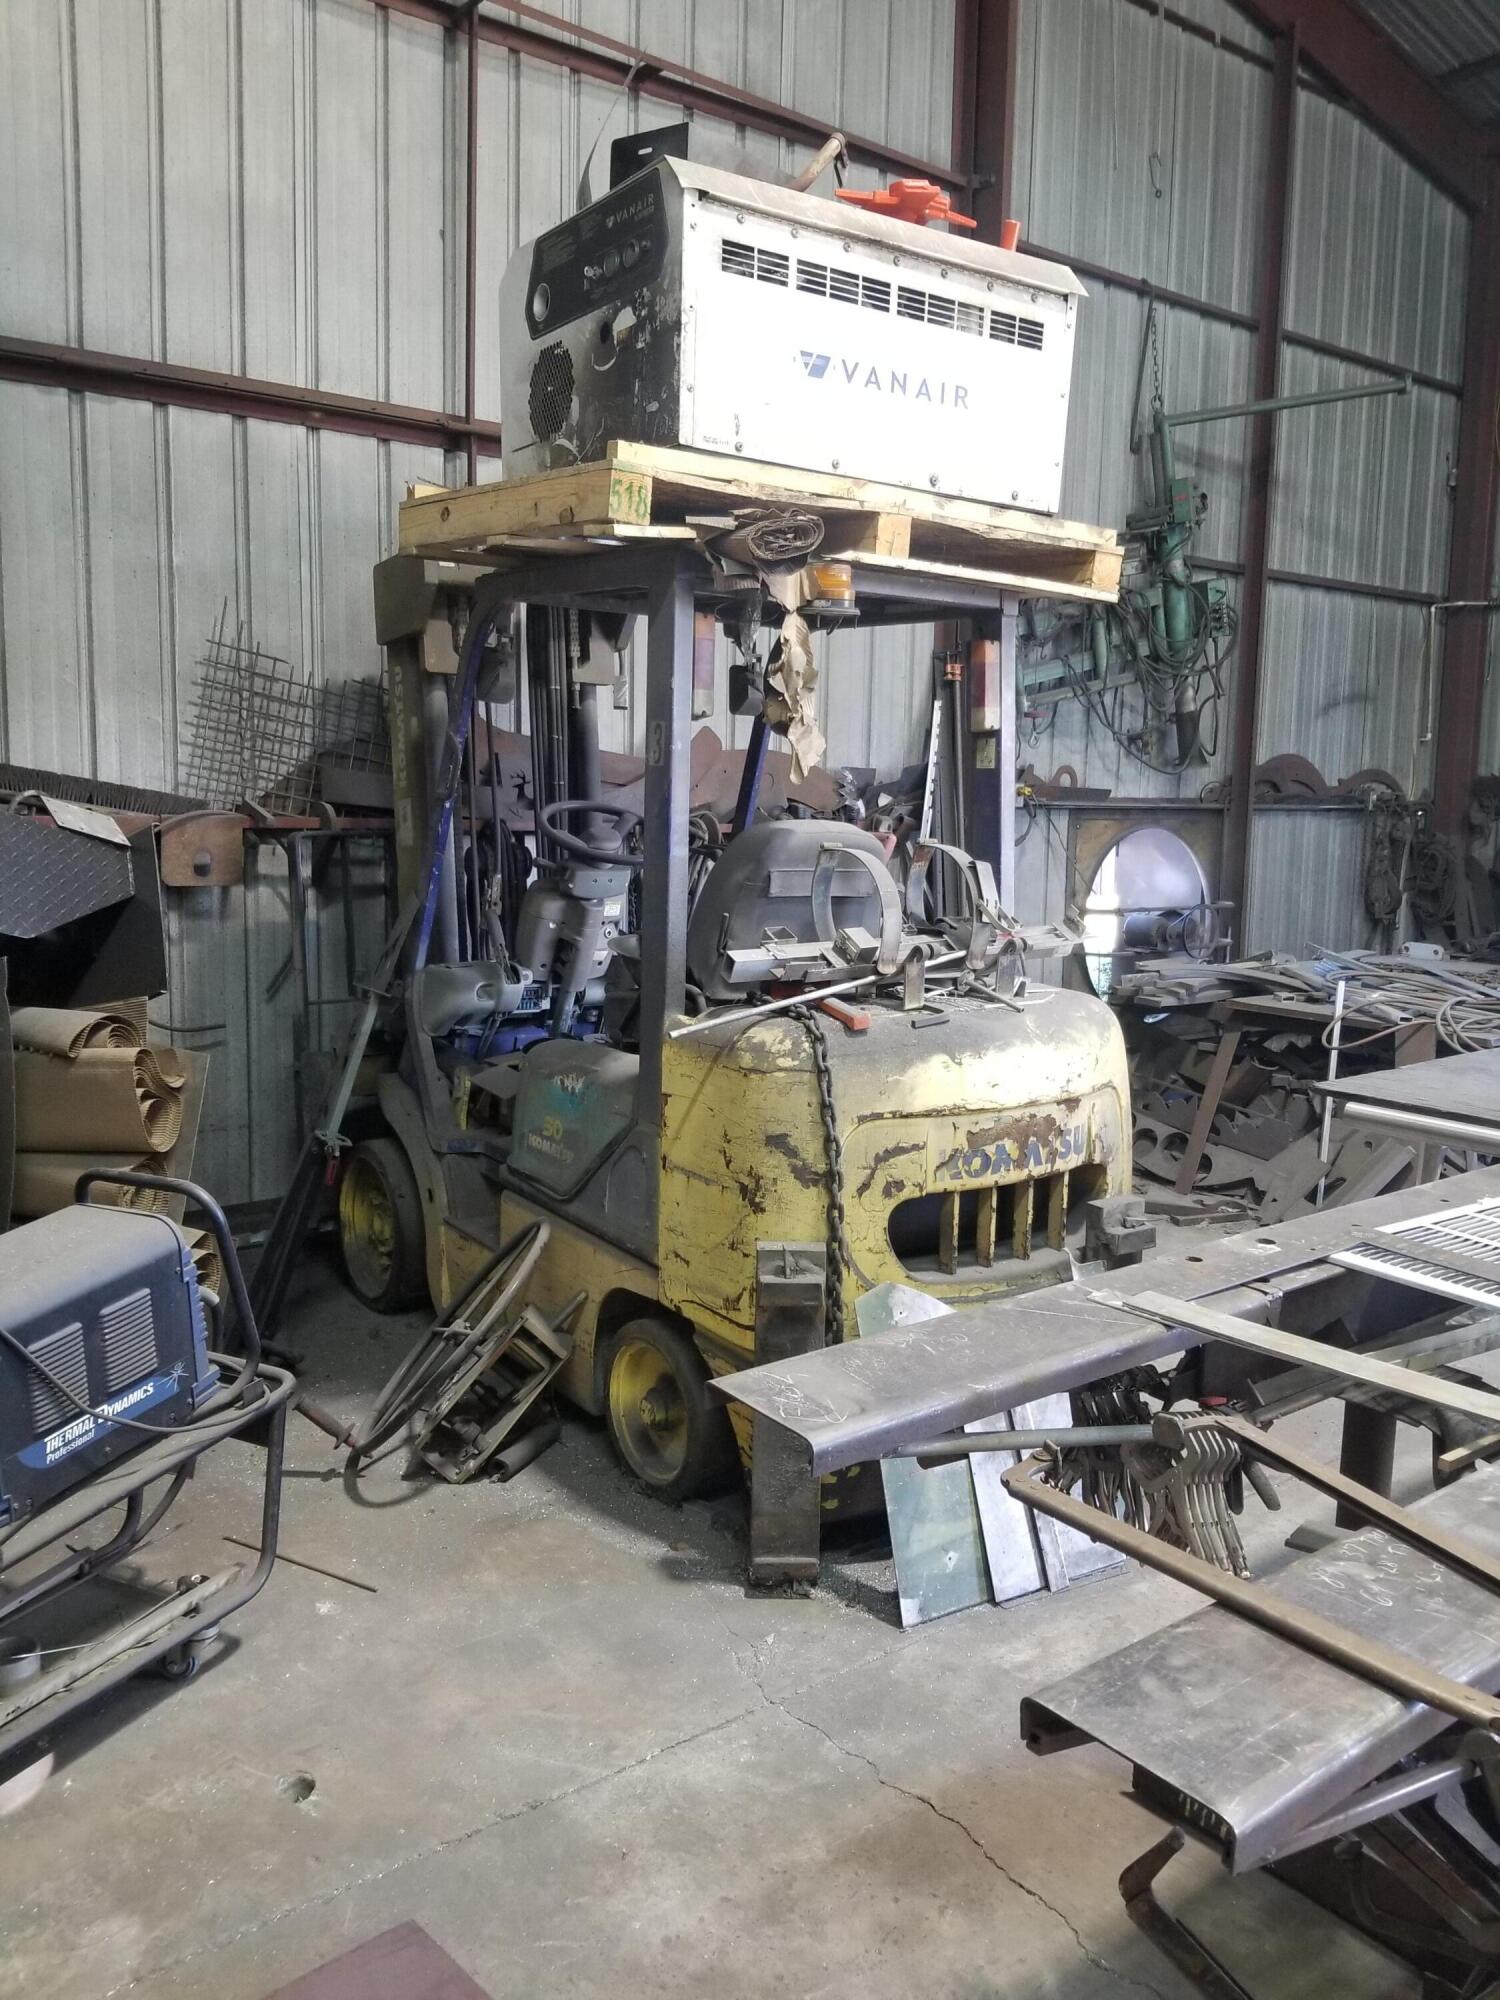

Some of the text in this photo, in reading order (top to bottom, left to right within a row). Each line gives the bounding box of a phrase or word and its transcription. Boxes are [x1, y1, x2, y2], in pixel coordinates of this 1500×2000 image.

[615, 193, 654, 223] VANAIR
[841, 358, 968, 410] VANAIR
[610, 478, 648, 519] 518
[394, 664, 407, 789] KOMATSU
[44, 1382, 154, 1454] THERMAL DYNAMICS
[46, 1429, 95, 1465] Professional
